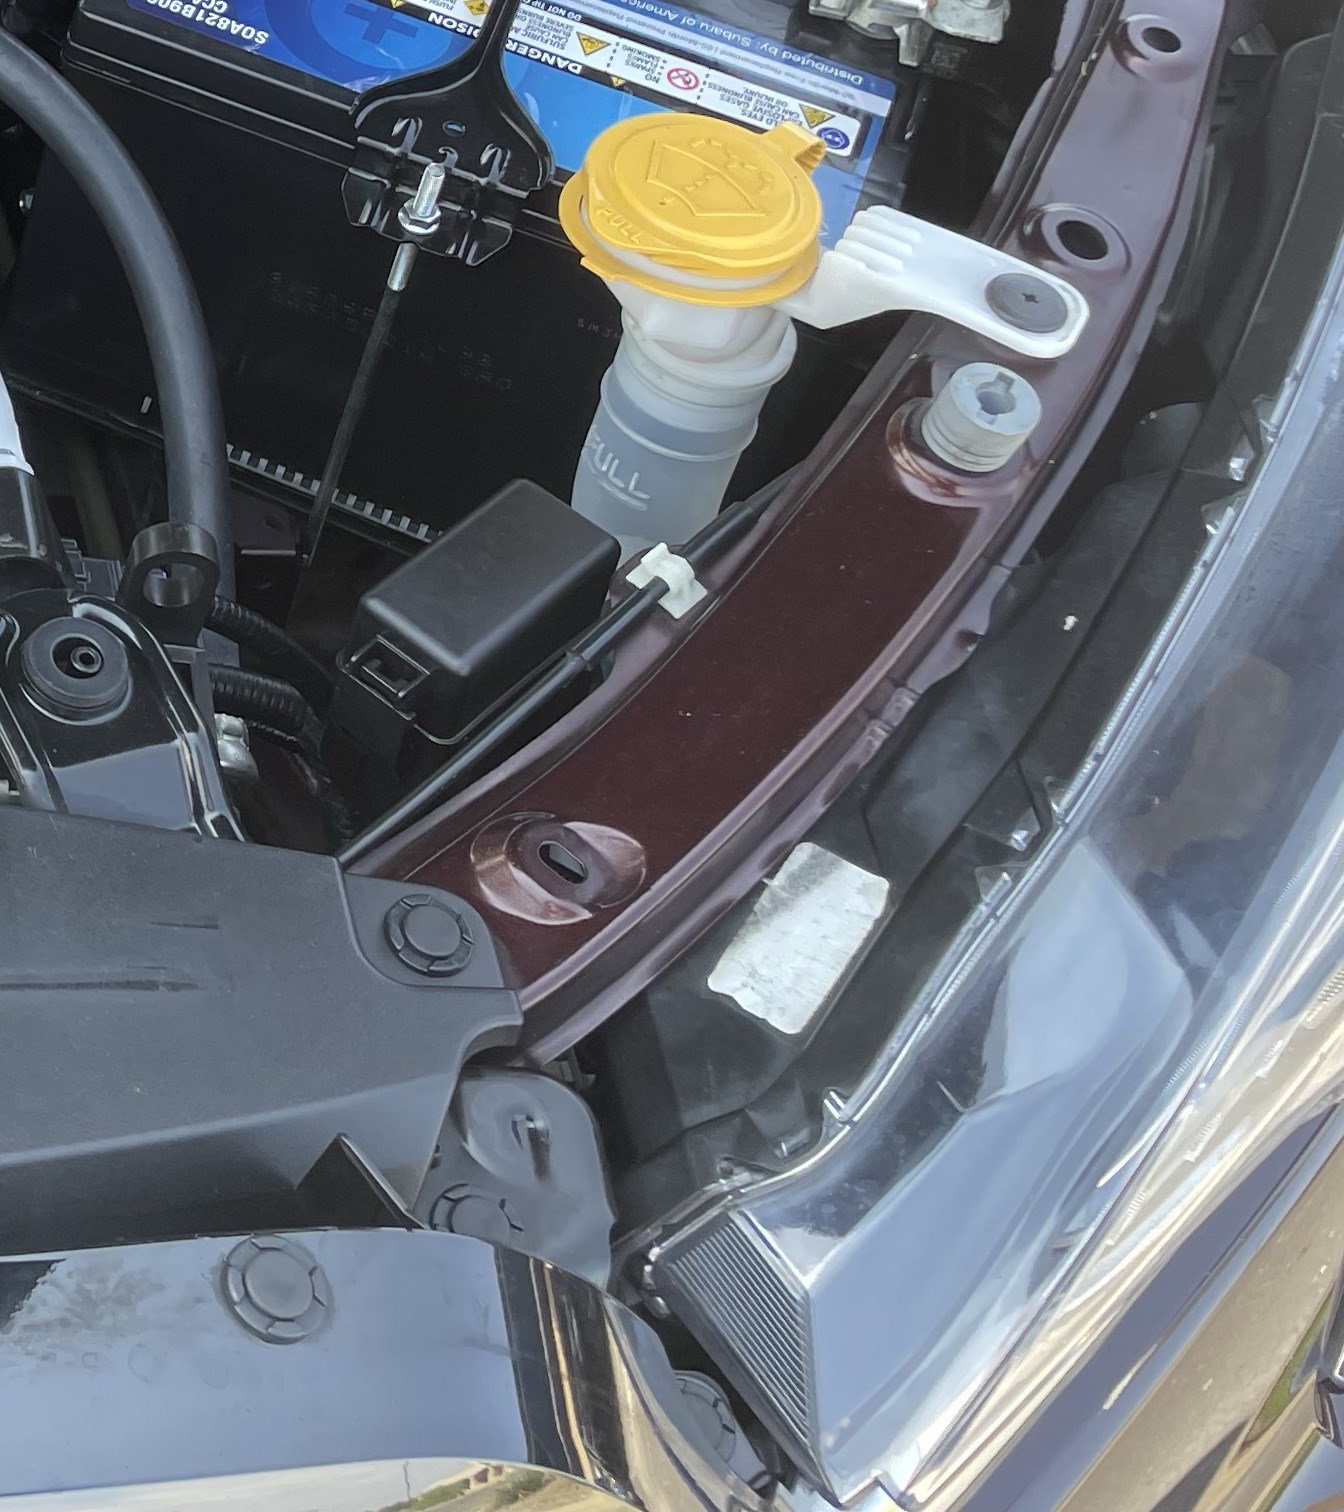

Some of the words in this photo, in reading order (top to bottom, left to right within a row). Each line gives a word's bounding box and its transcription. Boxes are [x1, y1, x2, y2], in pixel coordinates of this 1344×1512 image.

[546, 3, 567, 17] NOT
[566, 10, 582, 22] DO
[679, 15, 697, 29] of
[698, 21, 752, 48] Subaru
[503, 38, 583, 74] DANGER
[780, 48, 863, 86] Distributed
[643, 72, 660, 84] NO
[595, 207, 642, 245] PULL
